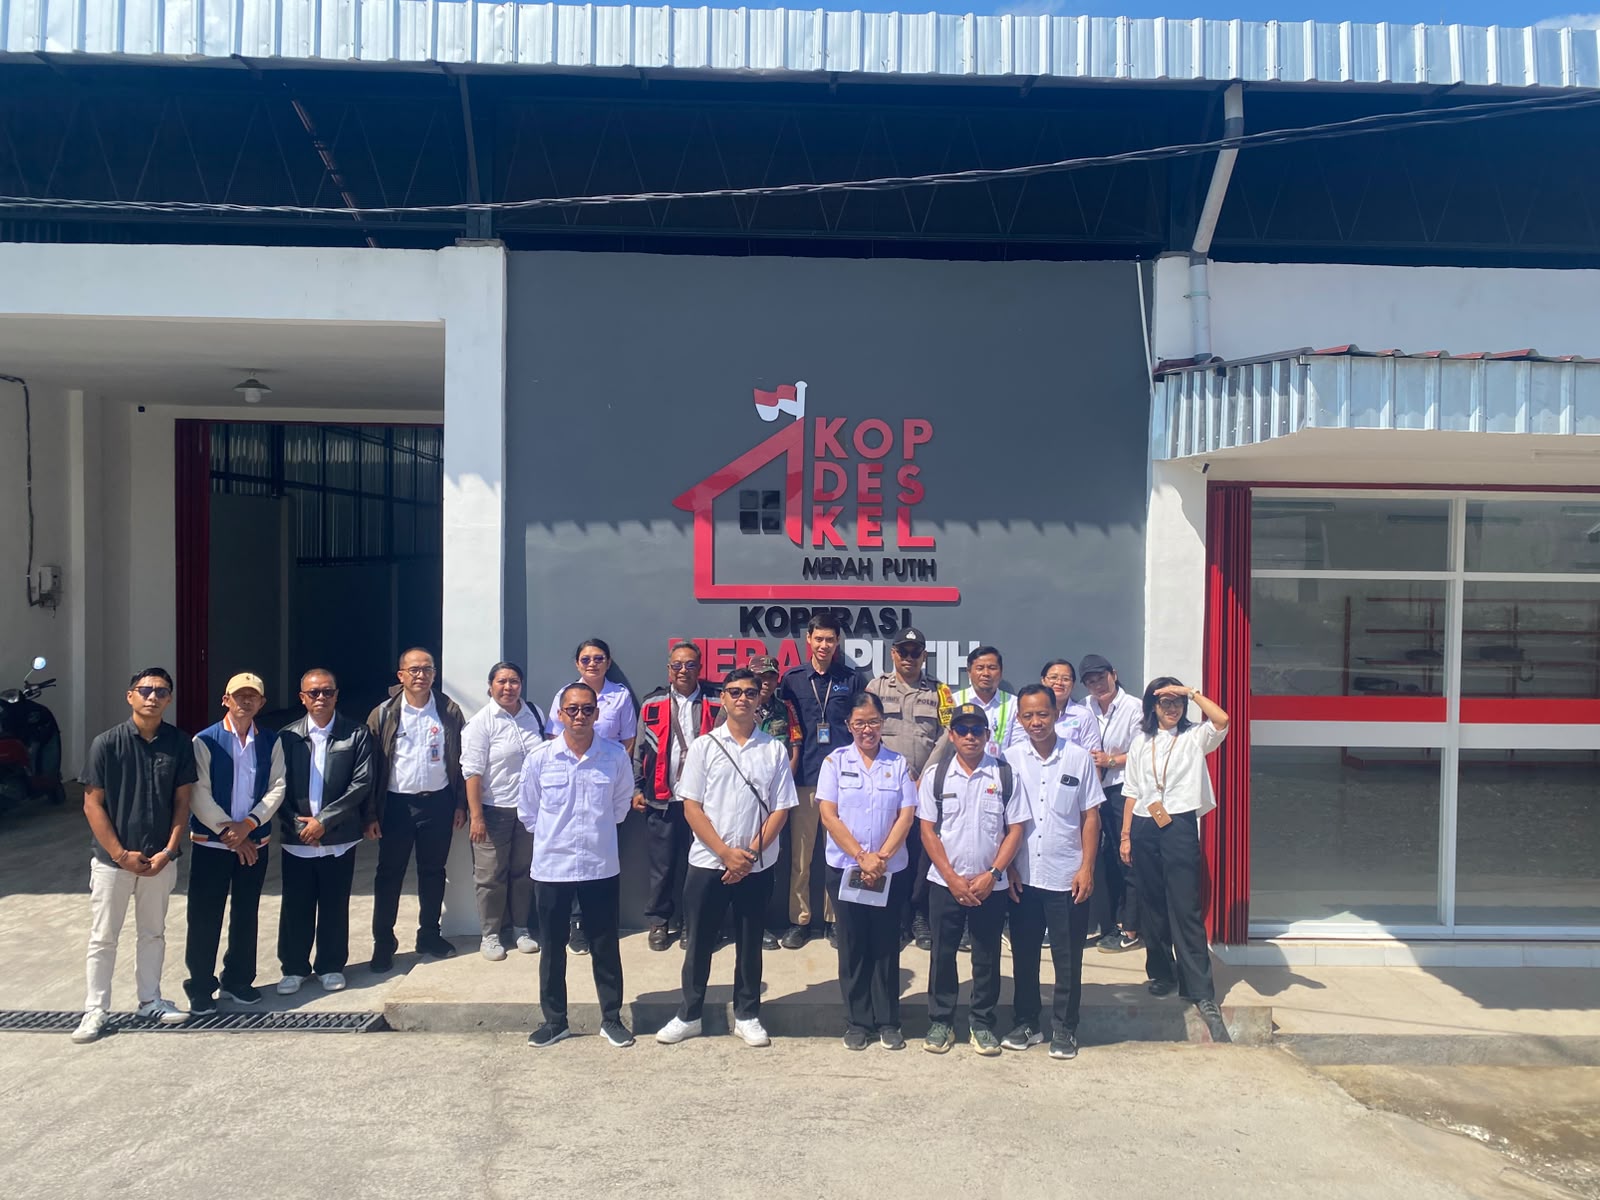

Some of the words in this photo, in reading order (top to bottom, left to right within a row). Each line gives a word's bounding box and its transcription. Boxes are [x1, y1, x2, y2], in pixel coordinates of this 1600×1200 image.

[814, 417, 934, 459] KOP
[813, 461, 925, 504] DES
[811, 506, 936, 548] KEL
[802, 557, 872, 578] MERAH
[882, 558, 937, 578] PUTIH
[739, 606, 912, 635] KOPRASI
[916, 698, 937, 707] POLRI
